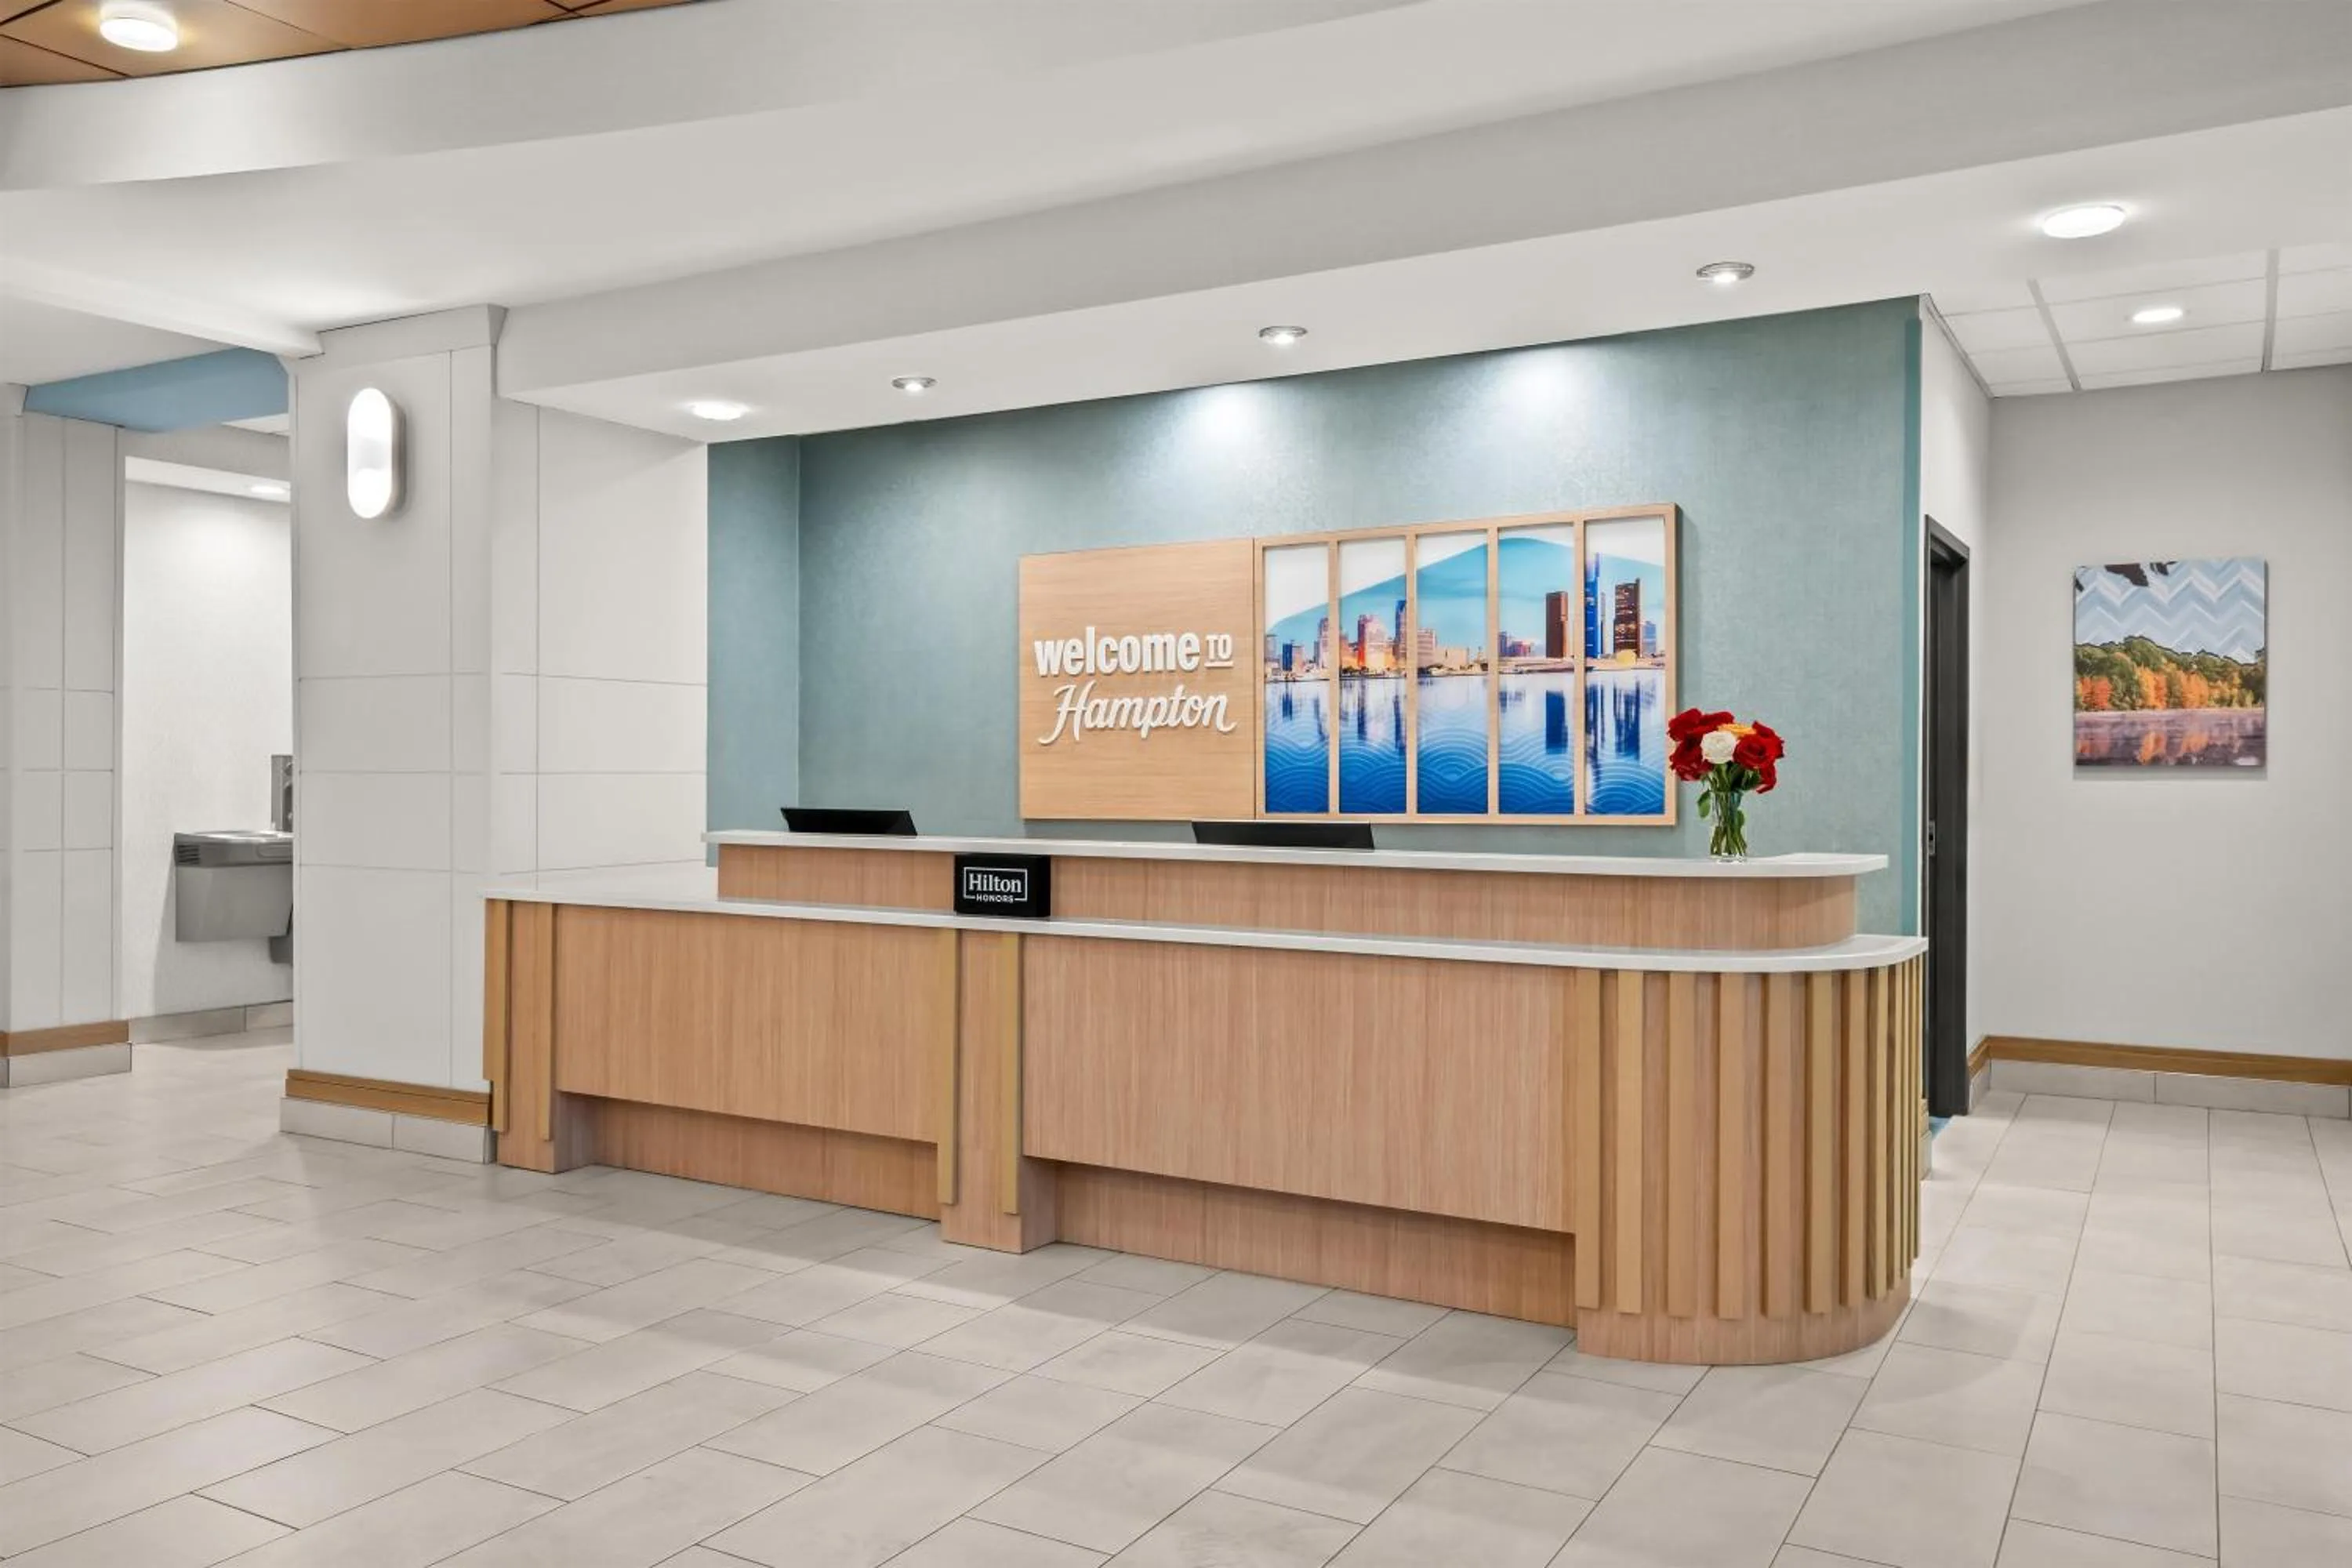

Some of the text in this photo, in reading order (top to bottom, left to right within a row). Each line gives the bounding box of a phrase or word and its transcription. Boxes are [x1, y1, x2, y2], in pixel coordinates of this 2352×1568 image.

[1034, 626, 1233, 676] welcome TO
[1038, 680, 1238, 745] Hampton
[968, 873, 1022, 893] Hilton
[976, 894, 1014, 903] HONORS
